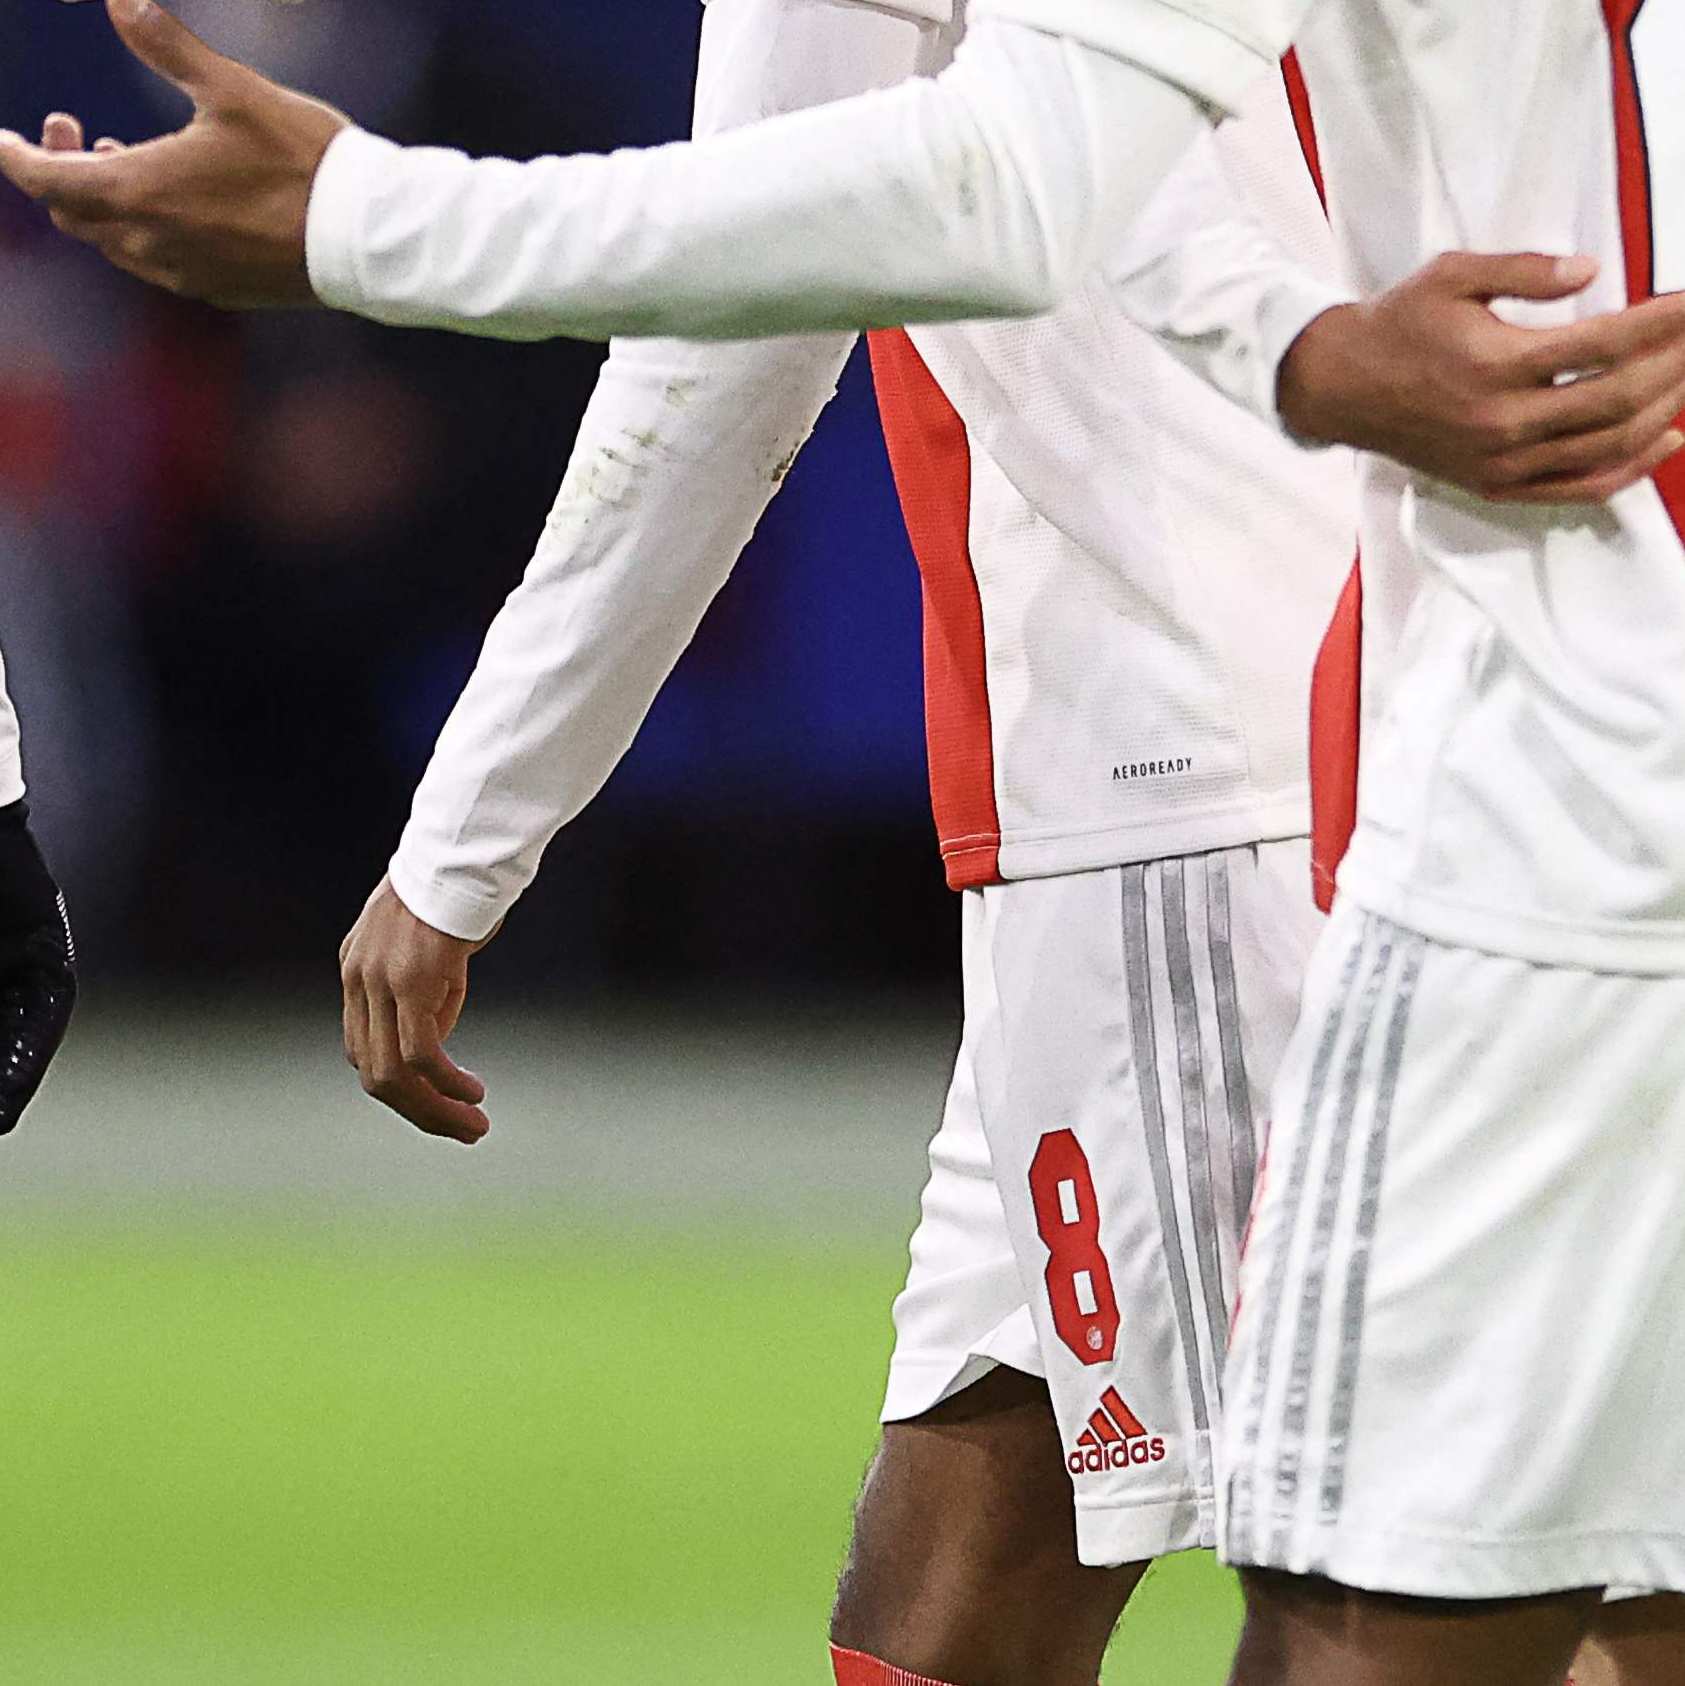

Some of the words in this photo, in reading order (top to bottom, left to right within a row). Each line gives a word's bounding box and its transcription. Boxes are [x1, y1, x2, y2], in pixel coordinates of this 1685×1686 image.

[1111, 756, 1193, 781] AEROREADY
[1027, 1127, 1121, 1367] 8
[1067, 1436, 1167, 1475] adidas
